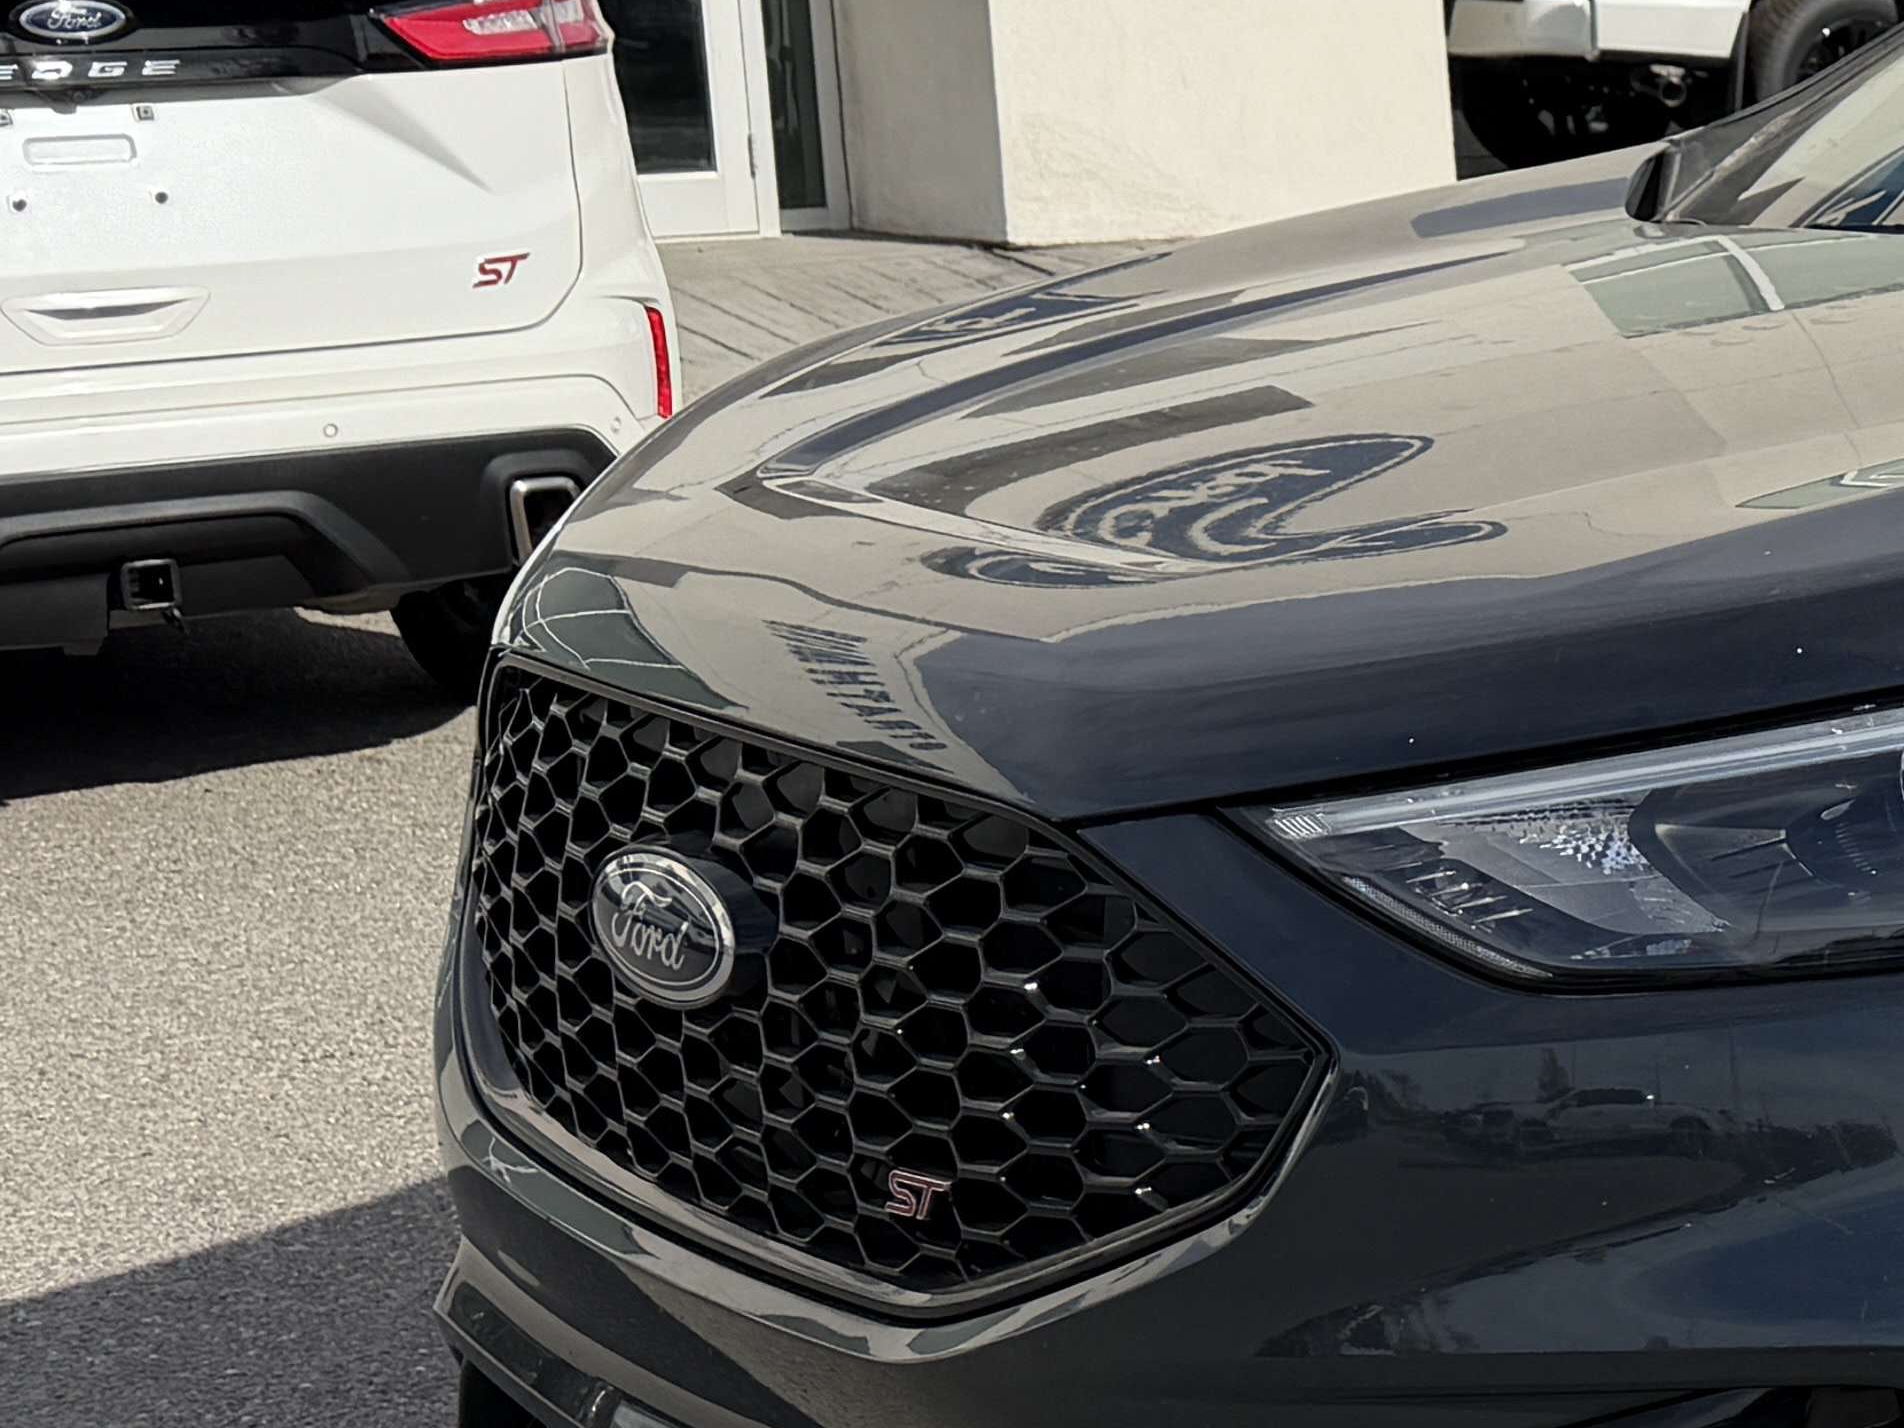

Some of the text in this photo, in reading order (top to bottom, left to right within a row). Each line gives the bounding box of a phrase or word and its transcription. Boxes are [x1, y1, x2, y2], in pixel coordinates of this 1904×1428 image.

[47, 6, 102, 29] Ford
[472, 252, 531, 289] ST
[610, 879, 690, 975] Ford
[884, 1168, 953, 1221] ST
